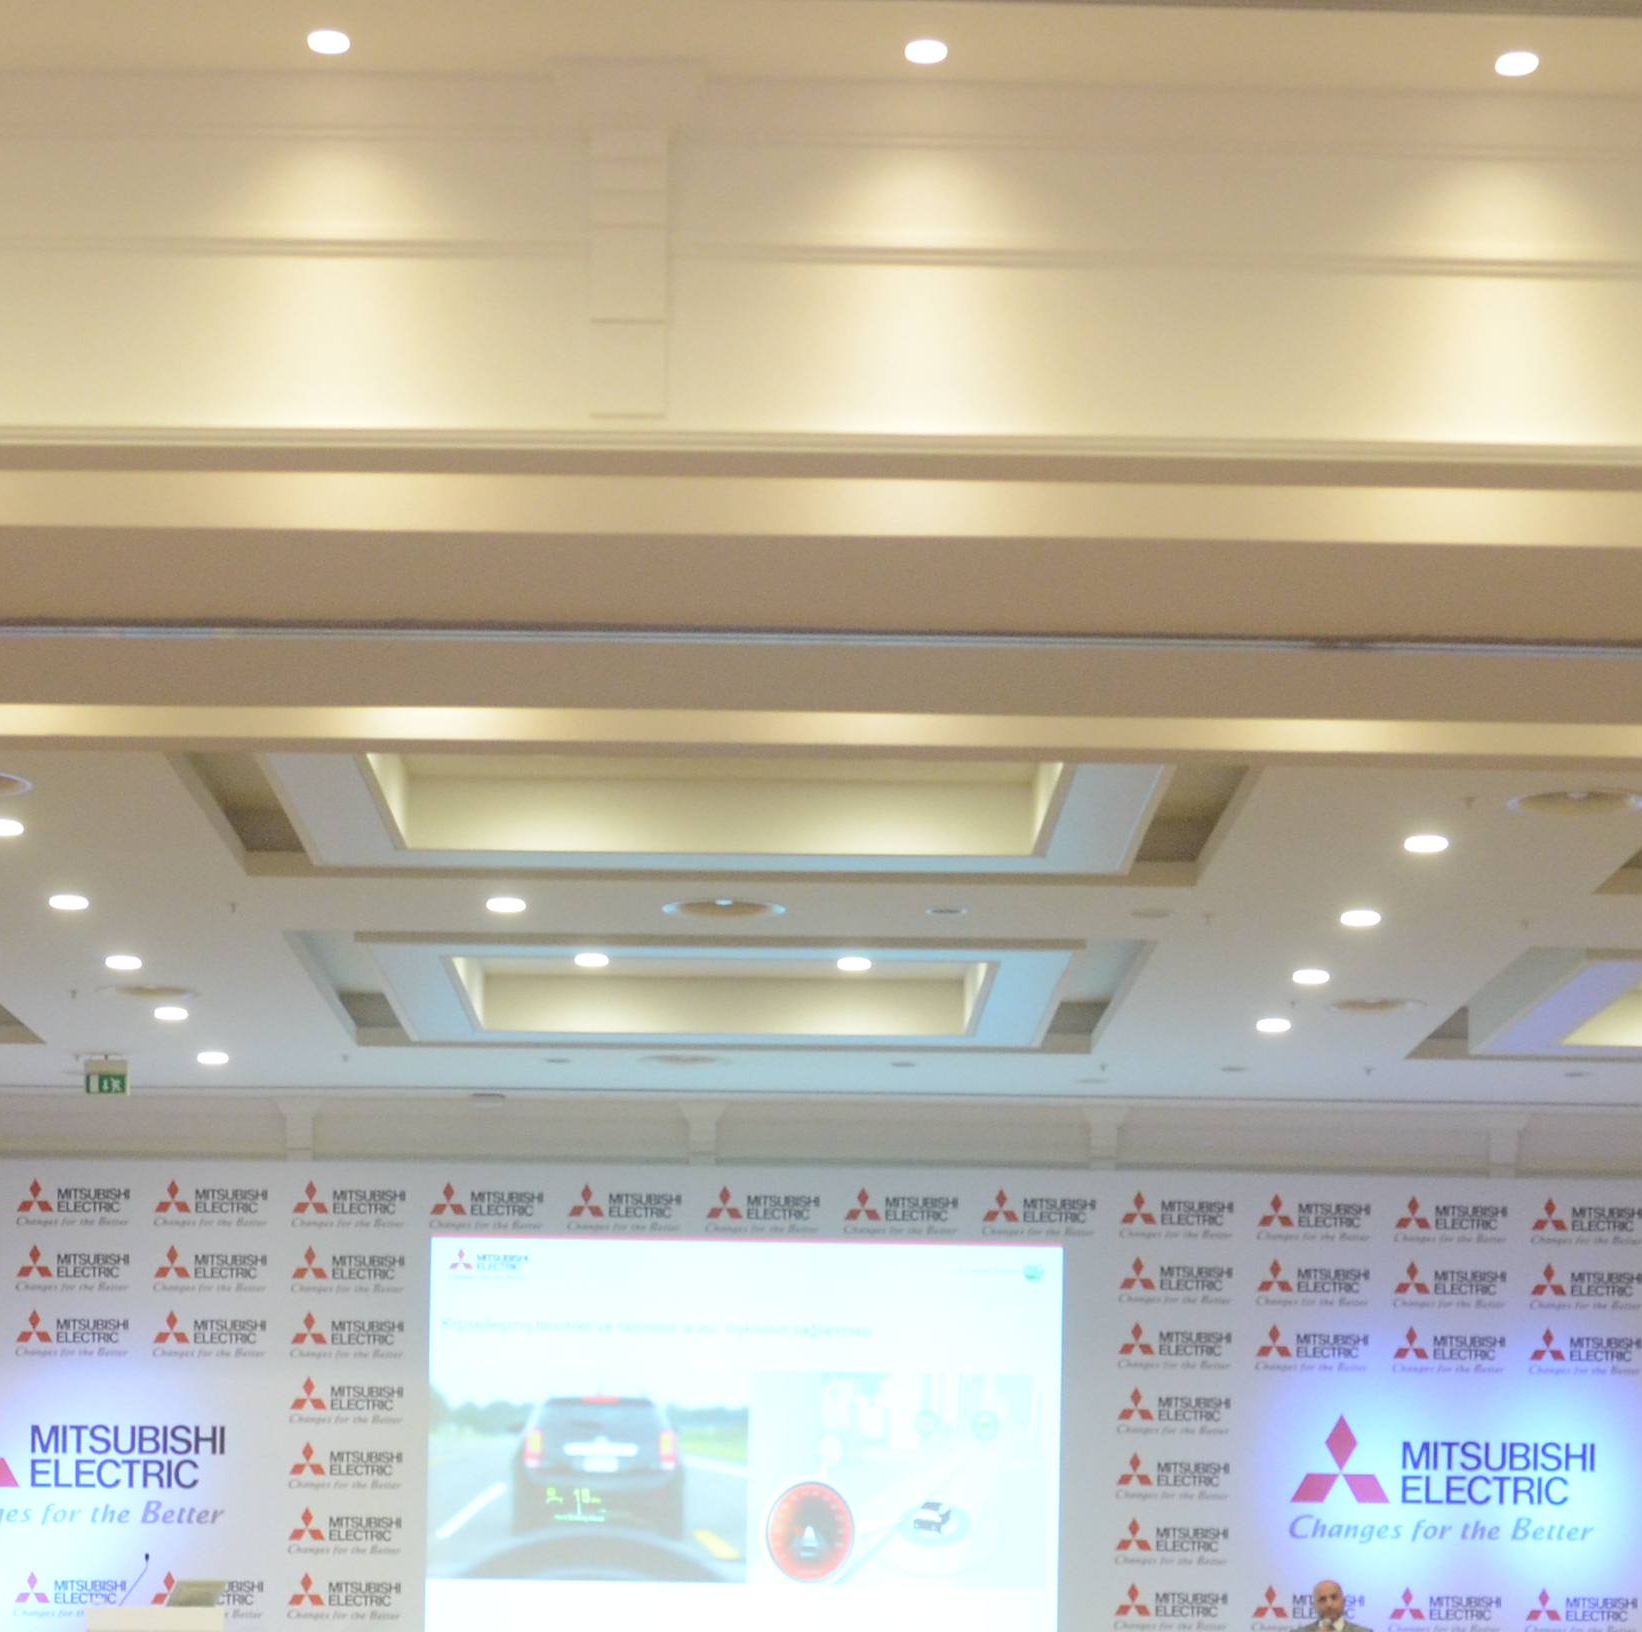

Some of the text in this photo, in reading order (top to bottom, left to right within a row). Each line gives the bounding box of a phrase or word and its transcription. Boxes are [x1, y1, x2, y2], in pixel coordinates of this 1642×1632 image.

[57, 1187, 130, 1201] MITSUBISHI
[194, 1188, 267, 1202] MITSUBISHI
[332, 1188, 405, 1202] MITSUBISHI
[470, 1190, 543, 1204] MITSUBISHI
[608, 1192, 681, 1206] MITSUBISHI
[746, 1194, 819, 1208] MITSUBISHI
[57, 1201, 121, 1214] ELECTRIC
[194, 1202, 258, 1215] ELECTRIC
[332, 1202, 396, 1215] ELECTRIC
[885, 1195, 958, 1209] MITSUBISHI
[1023, 1197, 1096, 1211] MITSUBISHI
[1160, 1200, 1233, 1214] MITSUBISHI
[1298, 1202, 1371, 1216] MITSUBISHI
[470, 1204, 534, 1217] ELECTRIC
[608, 1206, 672, 1219] ELECTRIC
[746, 1208, 810, 1221] ELECTRIC
[885, 1209, 949, 1222] ELECTRIC
[1023, 1211, 1087, 1224] ELECTRIC
[1435, 1204, 1508, 1218] MITSUBISHI
[1160, 1214, 1224, 1227] ELECTRIC
[1298, 1216, 1362, 1229] ELECTRIC
[1435, 1218, 1499, 1231] ELECTRIC
[1571, 1220, 1635, 1233] ELECTRIC
[56, 1252, 129, 1266] MITSUBISHI
[194, 1253, 267, 1267] MITSUBISHI
[332, 1254, 405, 1268] MITSUBISHI
[56, 1266, 120, 1279] ELECTRIC
[194, 1267, 258, 1280] ELECTRIC
[332, 1268, 396, 1281] ELECTRIC
[1159, 1265, 1232, 1279] MITSUBISHI
[1297, 1267, 1370, 1281] MITSUBISHI
[1434, 1269, 1507, 1283] MITSUBISHI
[1570, 1271, 1642, 1285] MITSUBISHI
[1159, 1279, 1223, 1292] ELECTRIC
[1297, 1281, 1361, 1294] ELECTRIC
[1434, 1283, 1498, 1296] ELECTRIC
[1570, 1285, 1634, 1298] ELECTRIC
[331, 1319, 404, 1333] MITSUBISHI
[331, 1333, 395, 1346] ELECTRIC
[1158, 1330, 1231, 1344] MITSUBISHI
[1158, 1344, 1222, 1357] ELECTRIC
[330, 1385, 403, 1399] MITSUBISHI
[330, 1399, 394, 1412] ELECTRIC
[1158, 1395, 1231, 1409] MITSUBISHI
[1158, 1409, 1222, 1422] ELECTRIC
[30, 1424, 226, 1455] MITSUBISHI
[329, 1450, 402, 1464] MITSUBISHI
[1401, 1441, 1596, 1472] MITSUBISHI
[30, 1459, 199, 1489] ELECTRIC
[329, 1464, 393, 1477] ELECTRIC
[1156, 1461, 1229, 1475] MITSUBISHI
[1156, 1475, 1220, 1488] ELECTRIC
[1401, 1475, 1569, 1505] ELECTRIC
[40, 1503, 82, 1525] for
[90, 1503, 130, 1524] the
[140, 1500, 224, 1525] Better
[328, 1515, 401, 1529] MITSUBISHI
[1288, 1514, 1595, 1544] Changes for the Better
[328, 1529, 392, 1542] ELECTRIC
[1155, 1526, 1228, 1540] MITSUBISHI
[1155, 1540, 1219, 1553] ELECTRIC
[328, 1581, 401, 1595] MITSUBISHI
[328, 1595, 392, 1608] ELECTRIC
[1155, 1591, 1228, 1605] MITSUBISHI
[1429, 1595, 1502, 1609] MITSUBISHI
[1155, 1605, 1219, 1618] ELECTRIC
[1429, 1609, 1493, 1622] ELECTRIC
